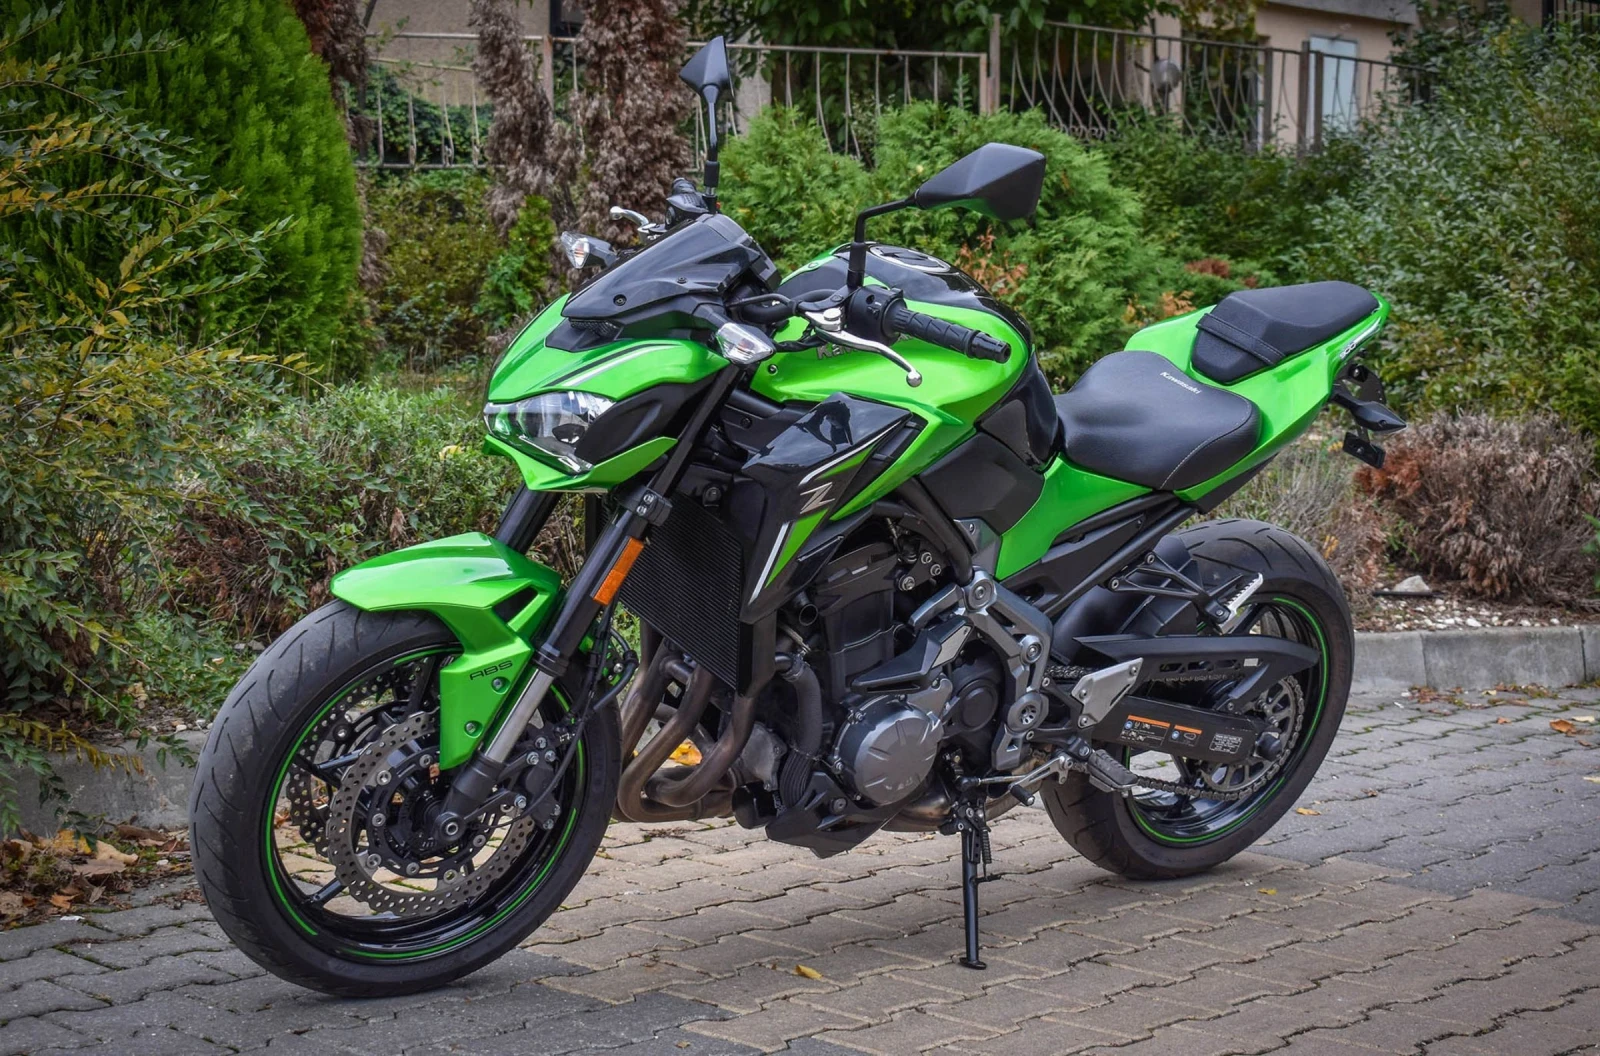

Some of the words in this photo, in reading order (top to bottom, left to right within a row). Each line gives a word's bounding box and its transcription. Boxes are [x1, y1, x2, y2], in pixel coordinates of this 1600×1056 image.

[1159, 371, 1203, 395] Kawasaki
[799, 481, 836, 515] Z
[469, 660, 513, 681] ABS
